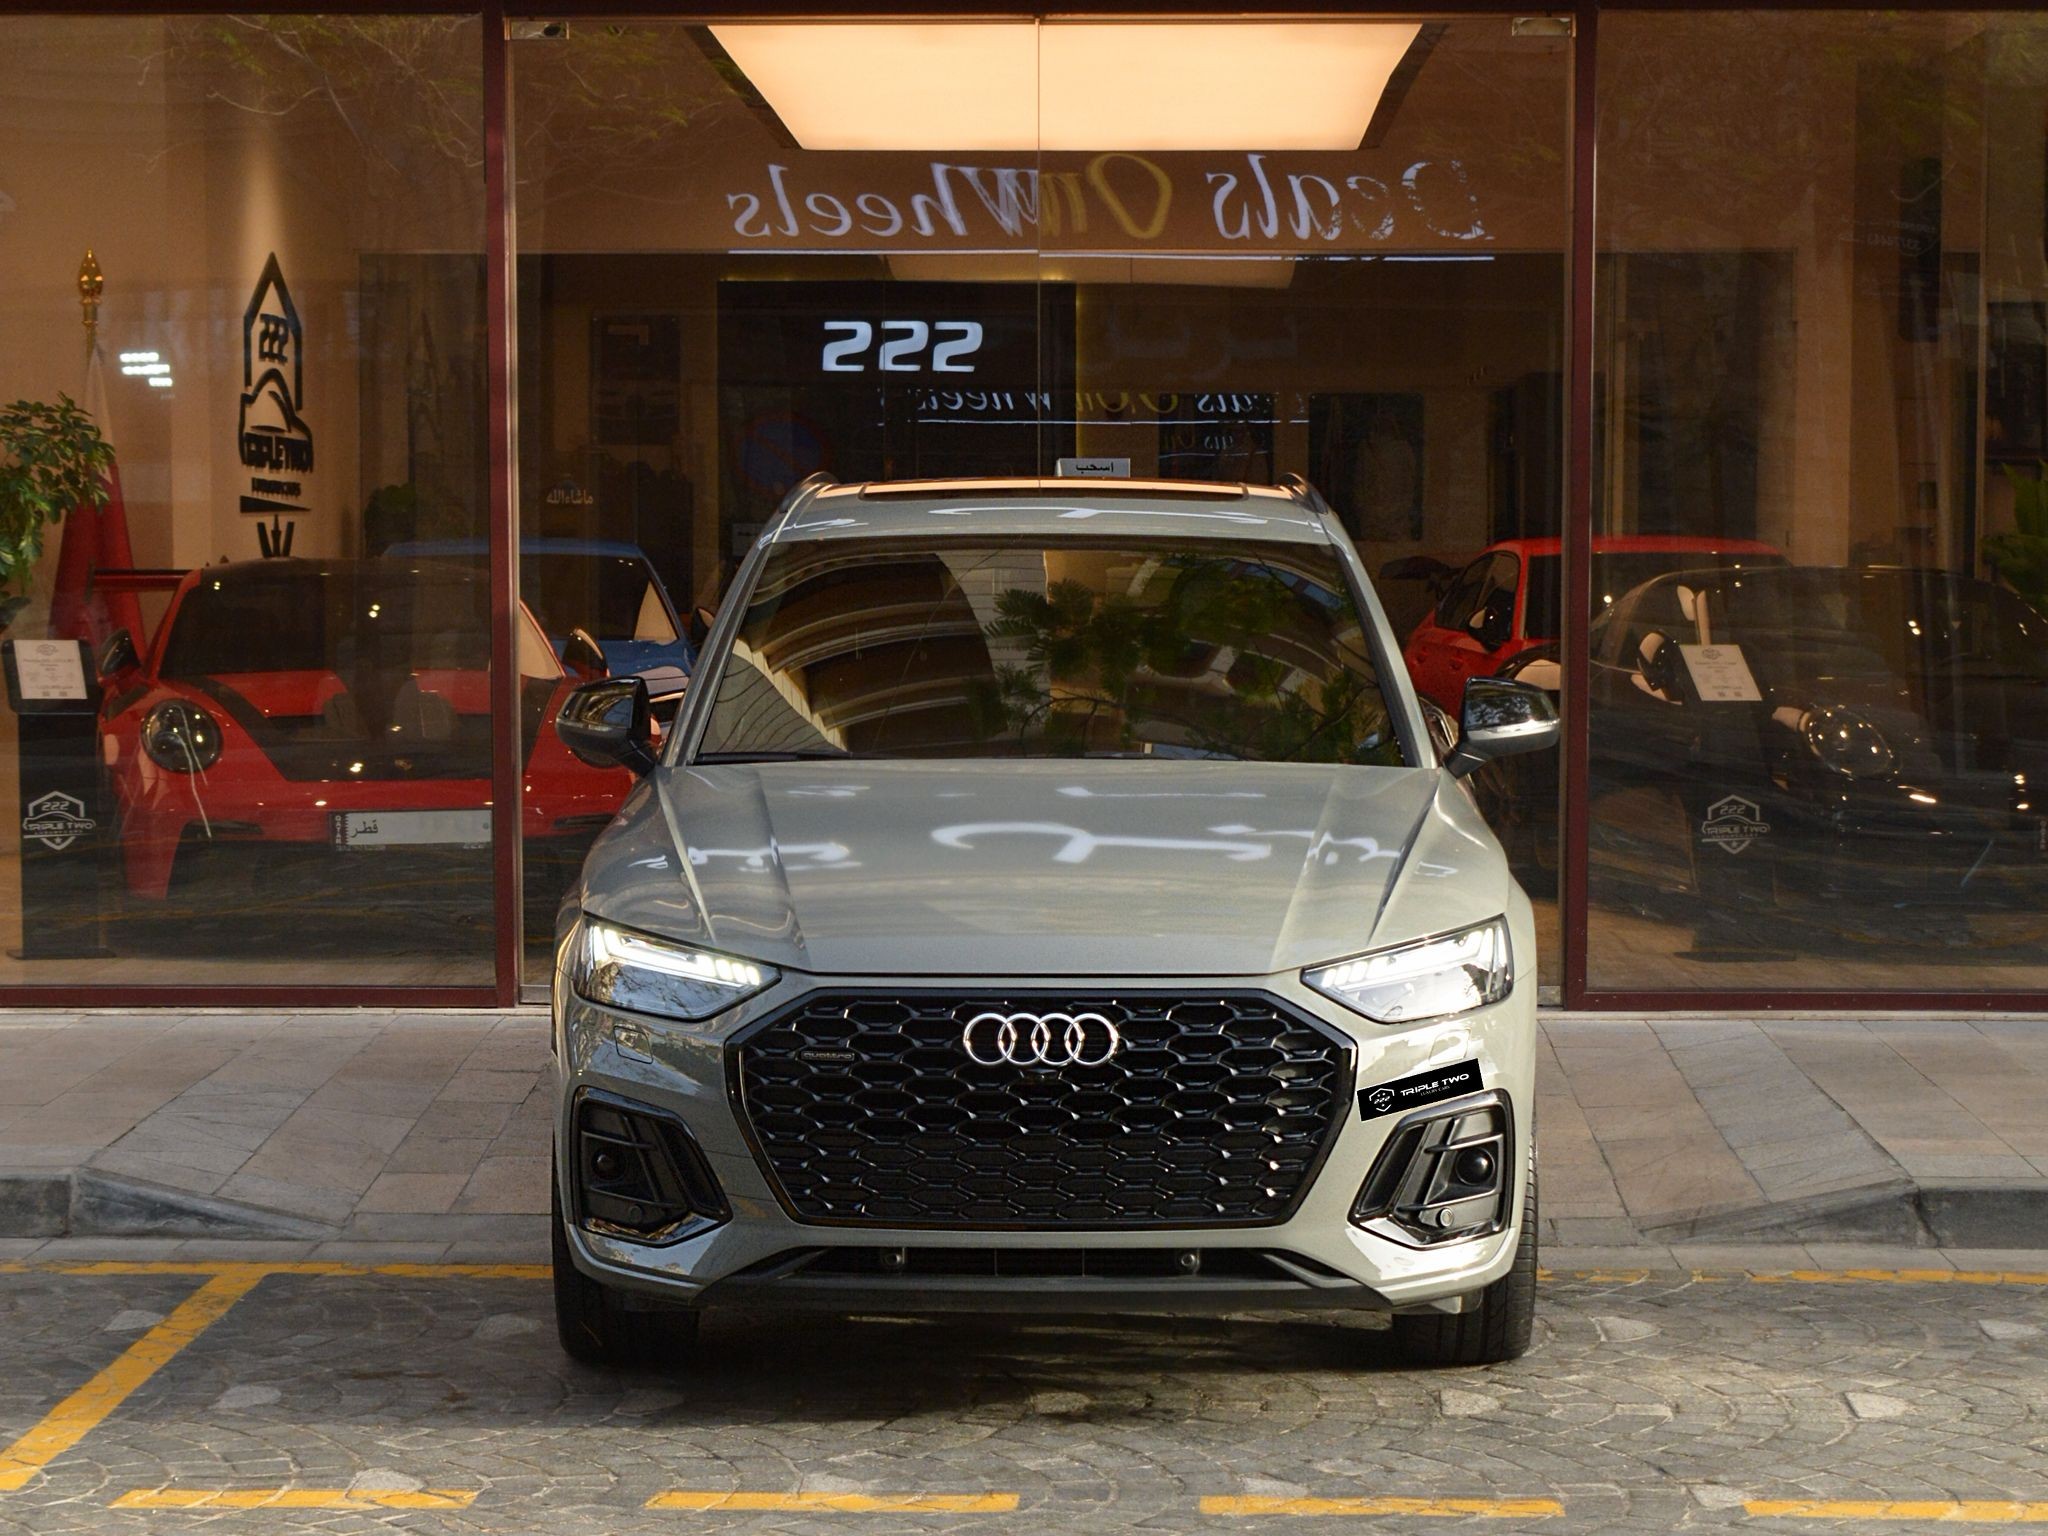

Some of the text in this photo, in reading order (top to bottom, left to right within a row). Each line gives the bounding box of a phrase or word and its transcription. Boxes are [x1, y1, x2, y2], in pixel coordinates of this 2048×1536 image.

[822, 320, 983, 372] 222
[42, 801, 70, 811] 222
[1720, 804, 1746, 815] 222
[350, 819, 379, 838] قطر
[1400, 1073, 1470, 1097] TRIPLE TWO
